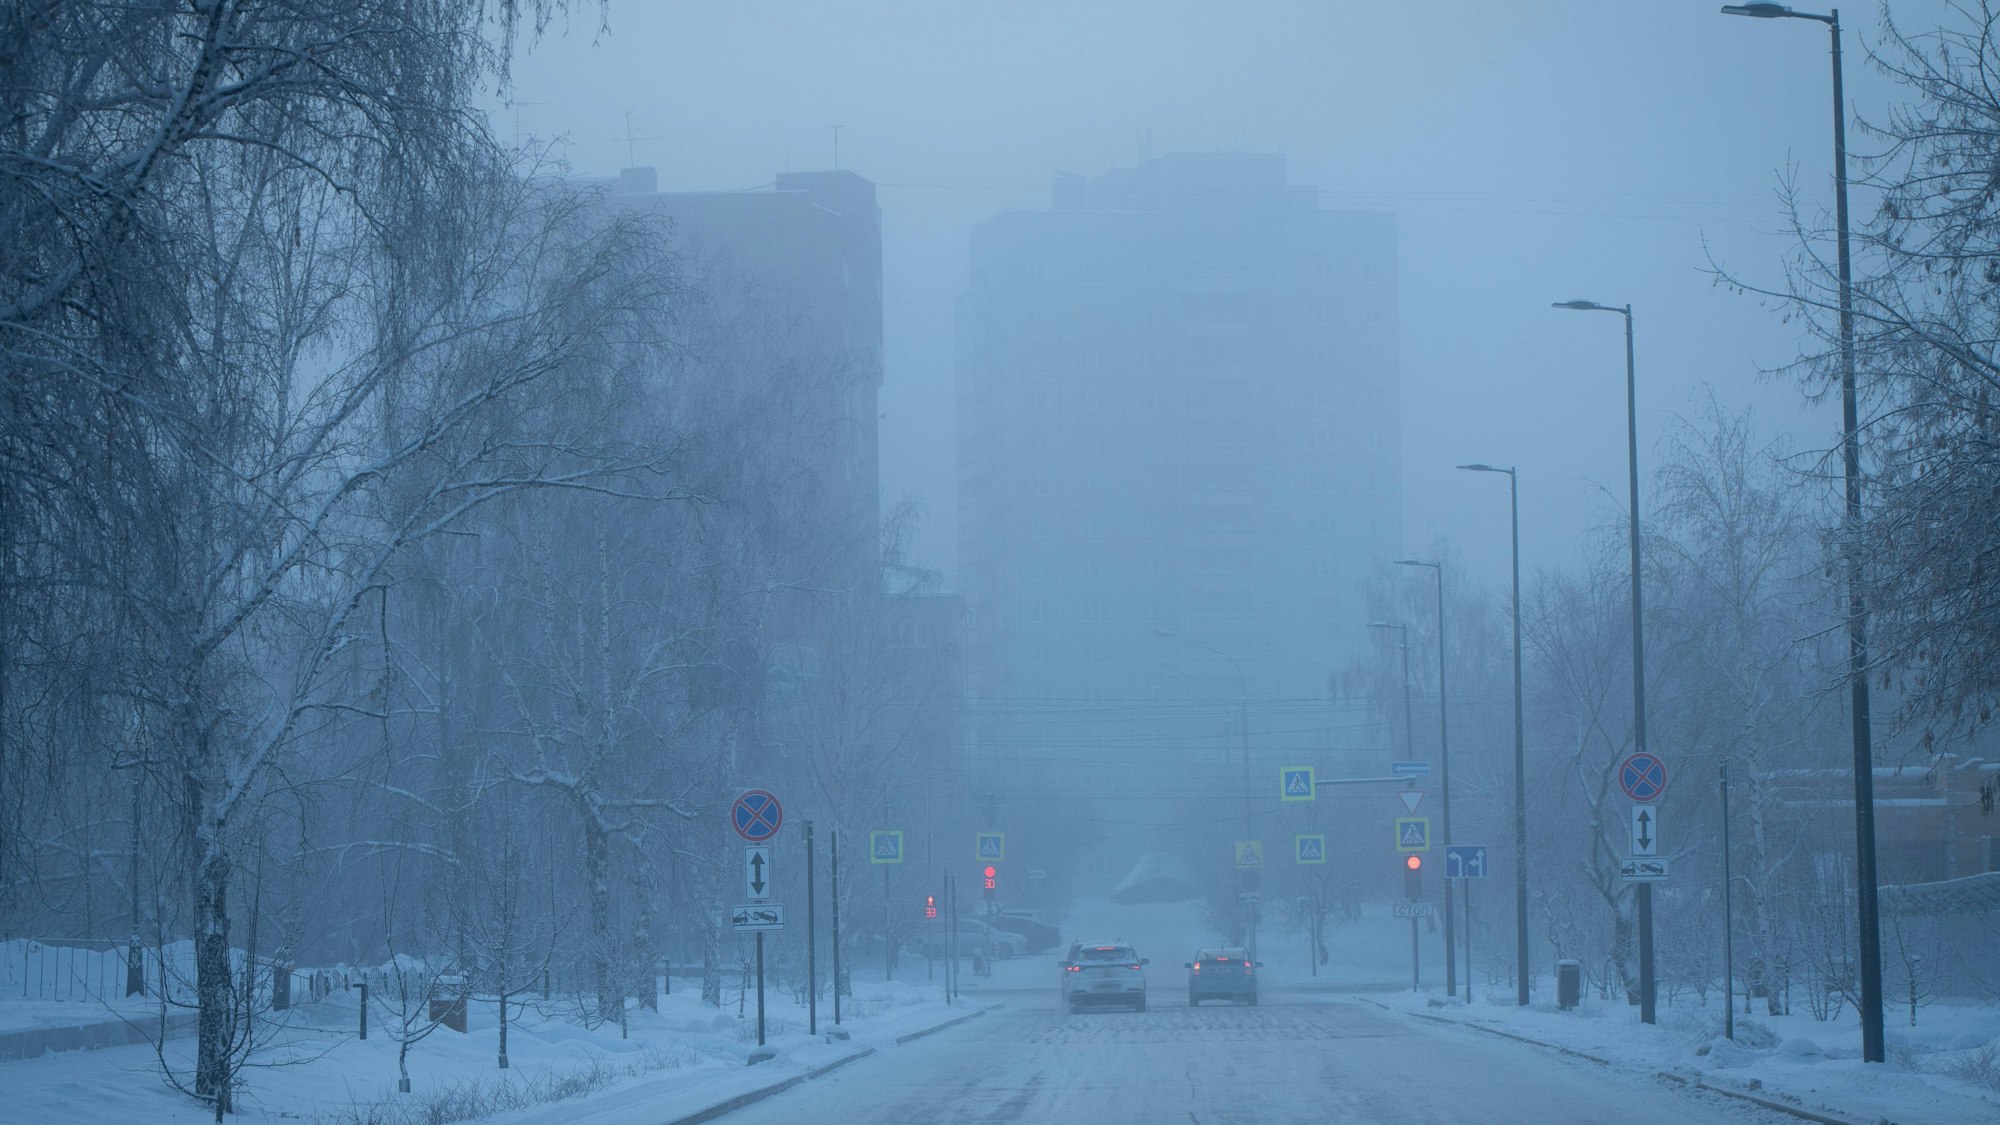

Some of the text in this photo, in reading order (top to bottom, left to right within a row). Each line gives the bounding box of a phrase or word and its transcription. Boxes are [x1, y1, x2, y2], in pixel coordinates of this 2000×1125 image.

[984, 878, 995, 889] 30
[925, 907, 936, 918] 33
[1399, 906, 1429, 916] СТОП
